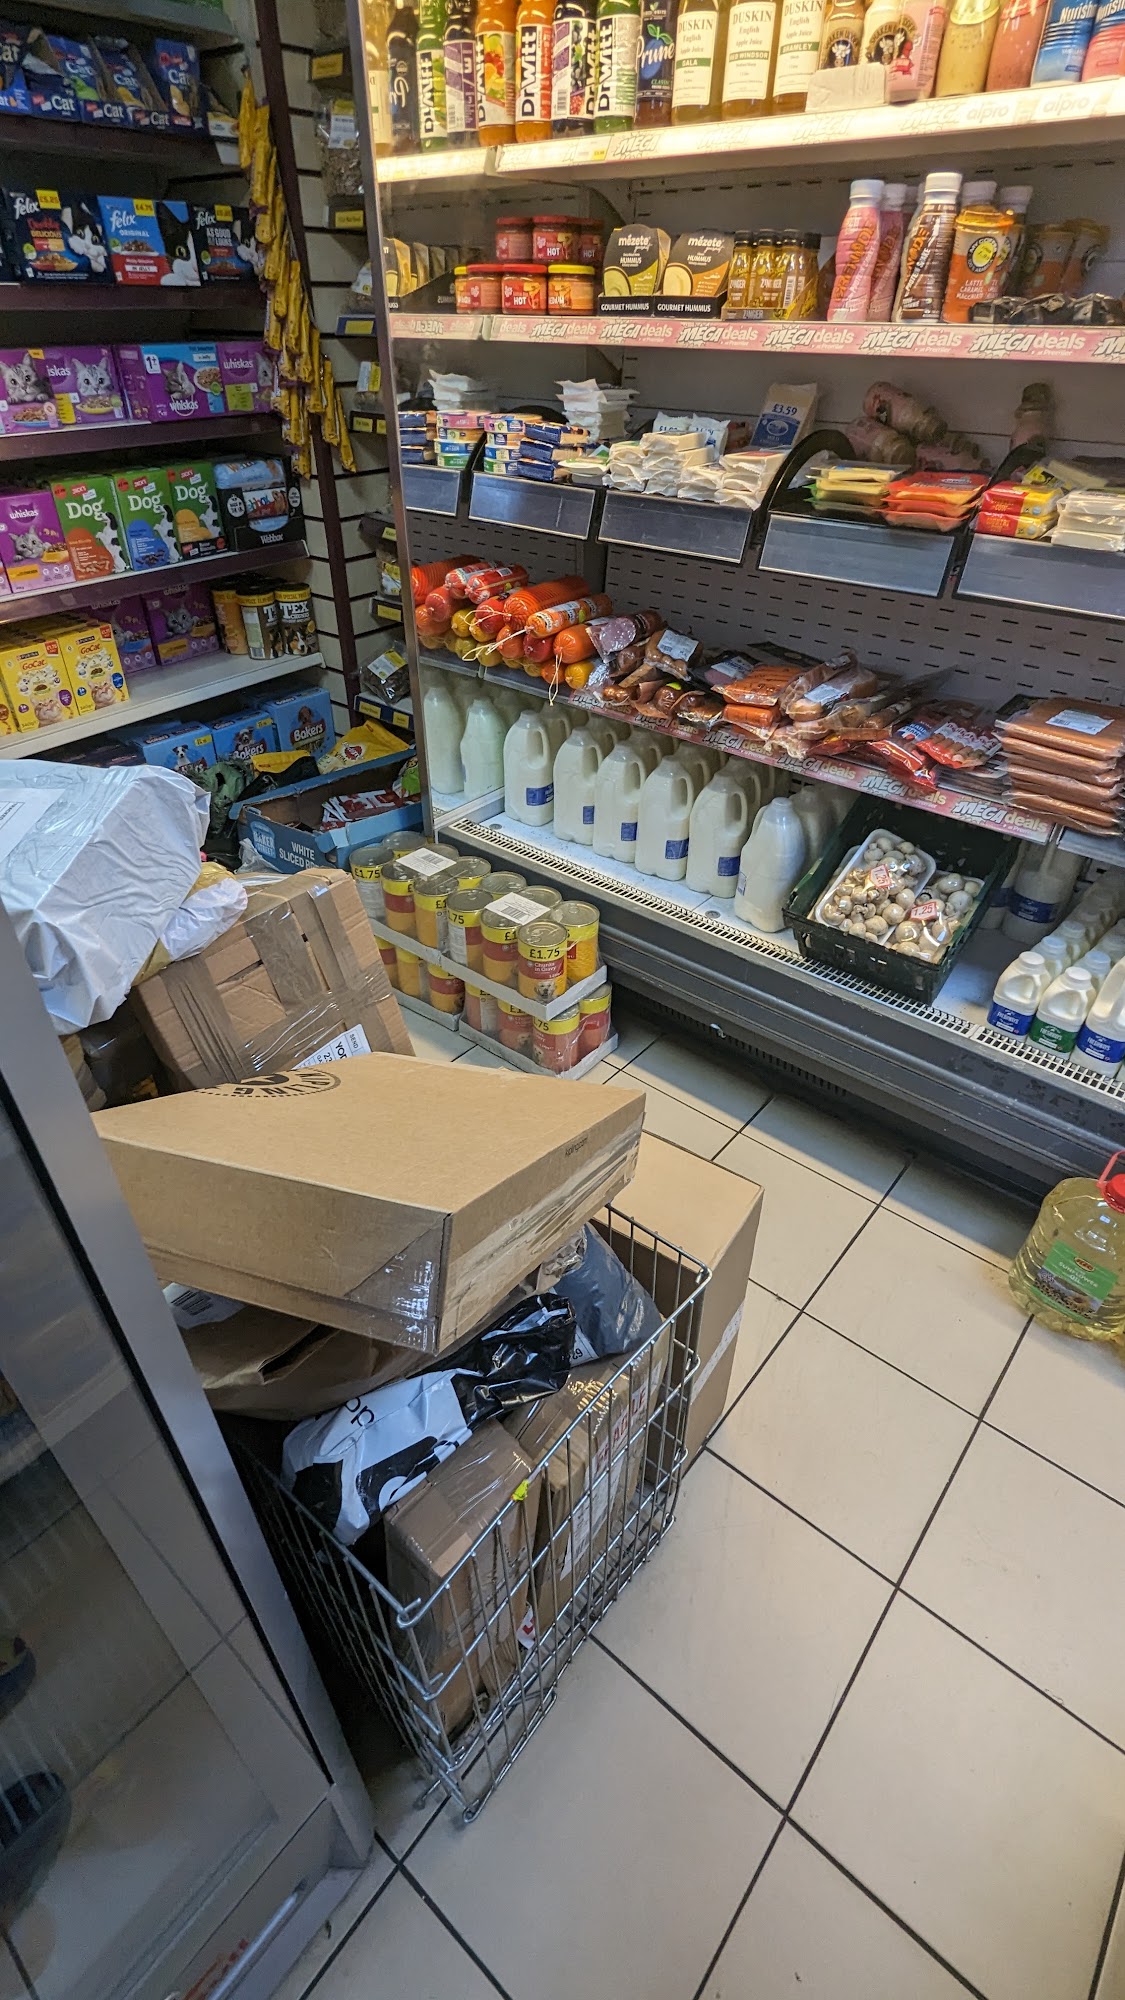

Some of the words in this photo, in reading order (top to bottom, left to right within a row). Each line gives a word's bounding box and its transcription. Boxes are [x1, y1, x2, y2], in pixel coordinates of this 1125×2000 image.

[785, 0, 823, 16] DUSKIN
[679, 18, 713, 33] DUSKIN
[733, 10, 772, 25] DUSKIN
[789, 15, 810, 27] English
[739, 25, 759, 35] English
[0, 43, 19, 63] at
[636, 35, 674, 69] Prune
[783, 43, 812, 53] BRAMLEY
[598, 23, 613, 112] DrWitt
[682, 59, 698, 67] GALA
[521, 30, 538, 117] DrWitt
[51, 95, 75, 112] Cat
[103, 103, 124, 119] Cat
[1043, 94, 1090, 116] alpro
[150, 111, 169, 126] Cat
[966, 102, 1008, 123] alpro
[14, 197, 40, 220] felix
[109, 210, 136, 232] felix
[195, 211, 217, 230] felix
[618, 234, 650, 247] mézete
[688, 236, 722, 248] mézete
[547, 247, 560, 256] HOT
[583, 249, 595, 258] HOT
[687, 255, 711, 263] HUMMUS
[620, 256, 642, 264] HUMMUS
[514, 297, 527, 305] HOT
[600, 303, 625, 311] GOURMET
[625, 302, 650, 311] HUMMUS
[657, 303, 684, 312] GOURMET
[684, 304, 711, 313] HUMMUS
[500, 321, 526, 334] deals
[531, 323, 568, 338] MEGA
[567, 321, 596, 336] deals
[601, 324, 642, 339] MEGA
[641, 323, 673, 338] deals
[679, 326, 721, 343] MEGA
[721, 326, 758, 342] deals
[765, 328, 816, 346] MEGA
[813, 328, 854, 344] deals
[862, 330, 919, 350] MEGA
[918, 330, 962, 348] deals
[972, 333, 1033, 353] MEGA
[1032, 331, 1085, 351] deals
[47, 365, 71, 377] iskas
[223, 358, 254, 370] whiskas
[170, 398, 198, 412] whiskas
[772, 403, 798, 416] £3.59
[174, 482, 208, 504] Dog
[65, 497, 106, 521] Dog
[127, 491, 163, 513] Dog
[9, 510, 39, 520] whiskas
[280, 601, 308, 616] TEX
[294, 724, 323, 741] Bakers
[704, 731, 745, 749] MEGA
[742, 738, 773, 757] deals
[821, 757, 856, 780] deals
[860, 774, 912, 797] MEGA
[953, 800, 1007, 824] MEGA
[1004, 810, 1048, 833] deals
[279, 848, 304, 867] SLICED
[291, 841, 315, 860] WHITE
[354, 867, 380, 879] £1.75
[913, 904, 933, 916] 1.25
[529, 948, 560, 960] £1.75
[1059, 1261, 1099, 1288] SUNFLOWER
[1069, 1274, 1081, 1283] OIL
